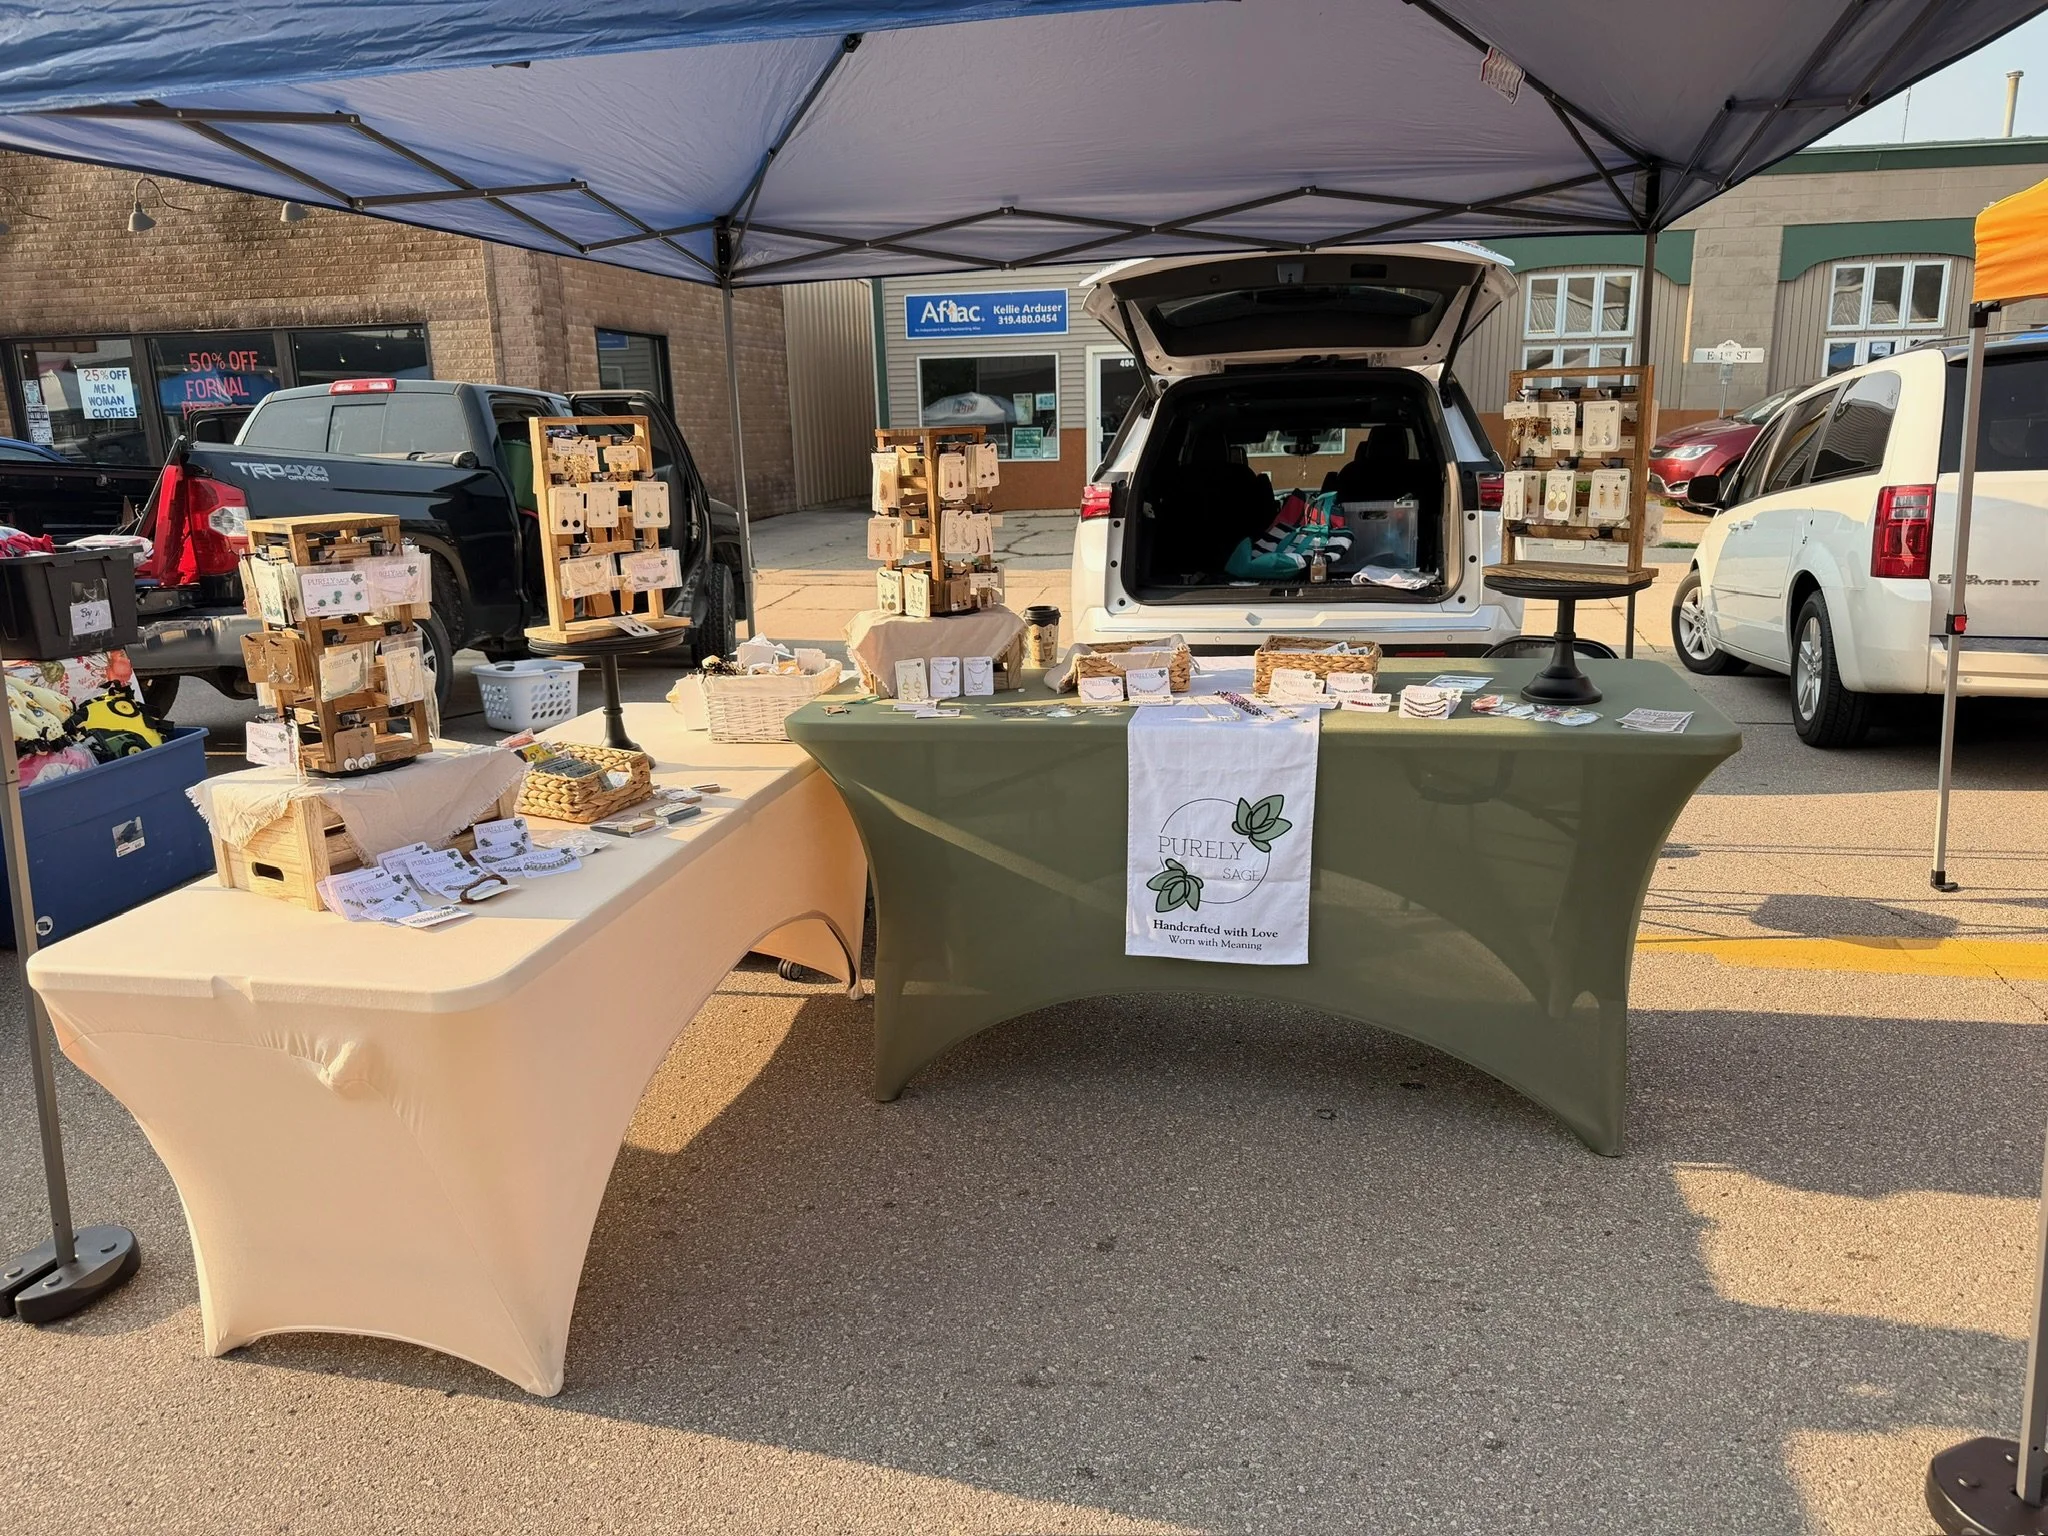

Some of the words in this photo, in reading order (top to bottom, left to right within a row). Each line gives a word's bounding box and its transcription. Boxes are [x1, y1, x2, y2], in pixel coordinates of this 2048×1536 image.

[920, 300, 980, 323] Aflac
[993, 304, 1020, 315] Kellie
[1022, 303, 1062, 314] Arduser
[998, 314, 1057, 325] 319.480.0454
[188, 352, 226, 373] 50%
[228, 350, 258, 371] OFF
[1707, 351, 1715, 360] E
[1736, 351, 1751, 360] ST
[83, 369, 109, 382] 25%
[109, 370, 127, 380] OFF
[93, 383, 116, 394] MEN
[185, 377, 250, 400] FORMAL
[87, 395, 125, 407] WOMAN
[92, 407, 136, 418] CLOTHES
[2011, 579, 2040, 587] SXT
[1158, 835, 1248, 861] PURELY
[1222, 867, 1262, 881] SAGE
[1153, 919, 1221, 935] Handcrafted
[1223, 927, 1248, 938] with
[1251, 927, 1279, 939] Love
[1168, 934, 1196, 945] Worn
[1197, 937, 1219, 947] with
[1220, 939, 1263, 951] Meaning
